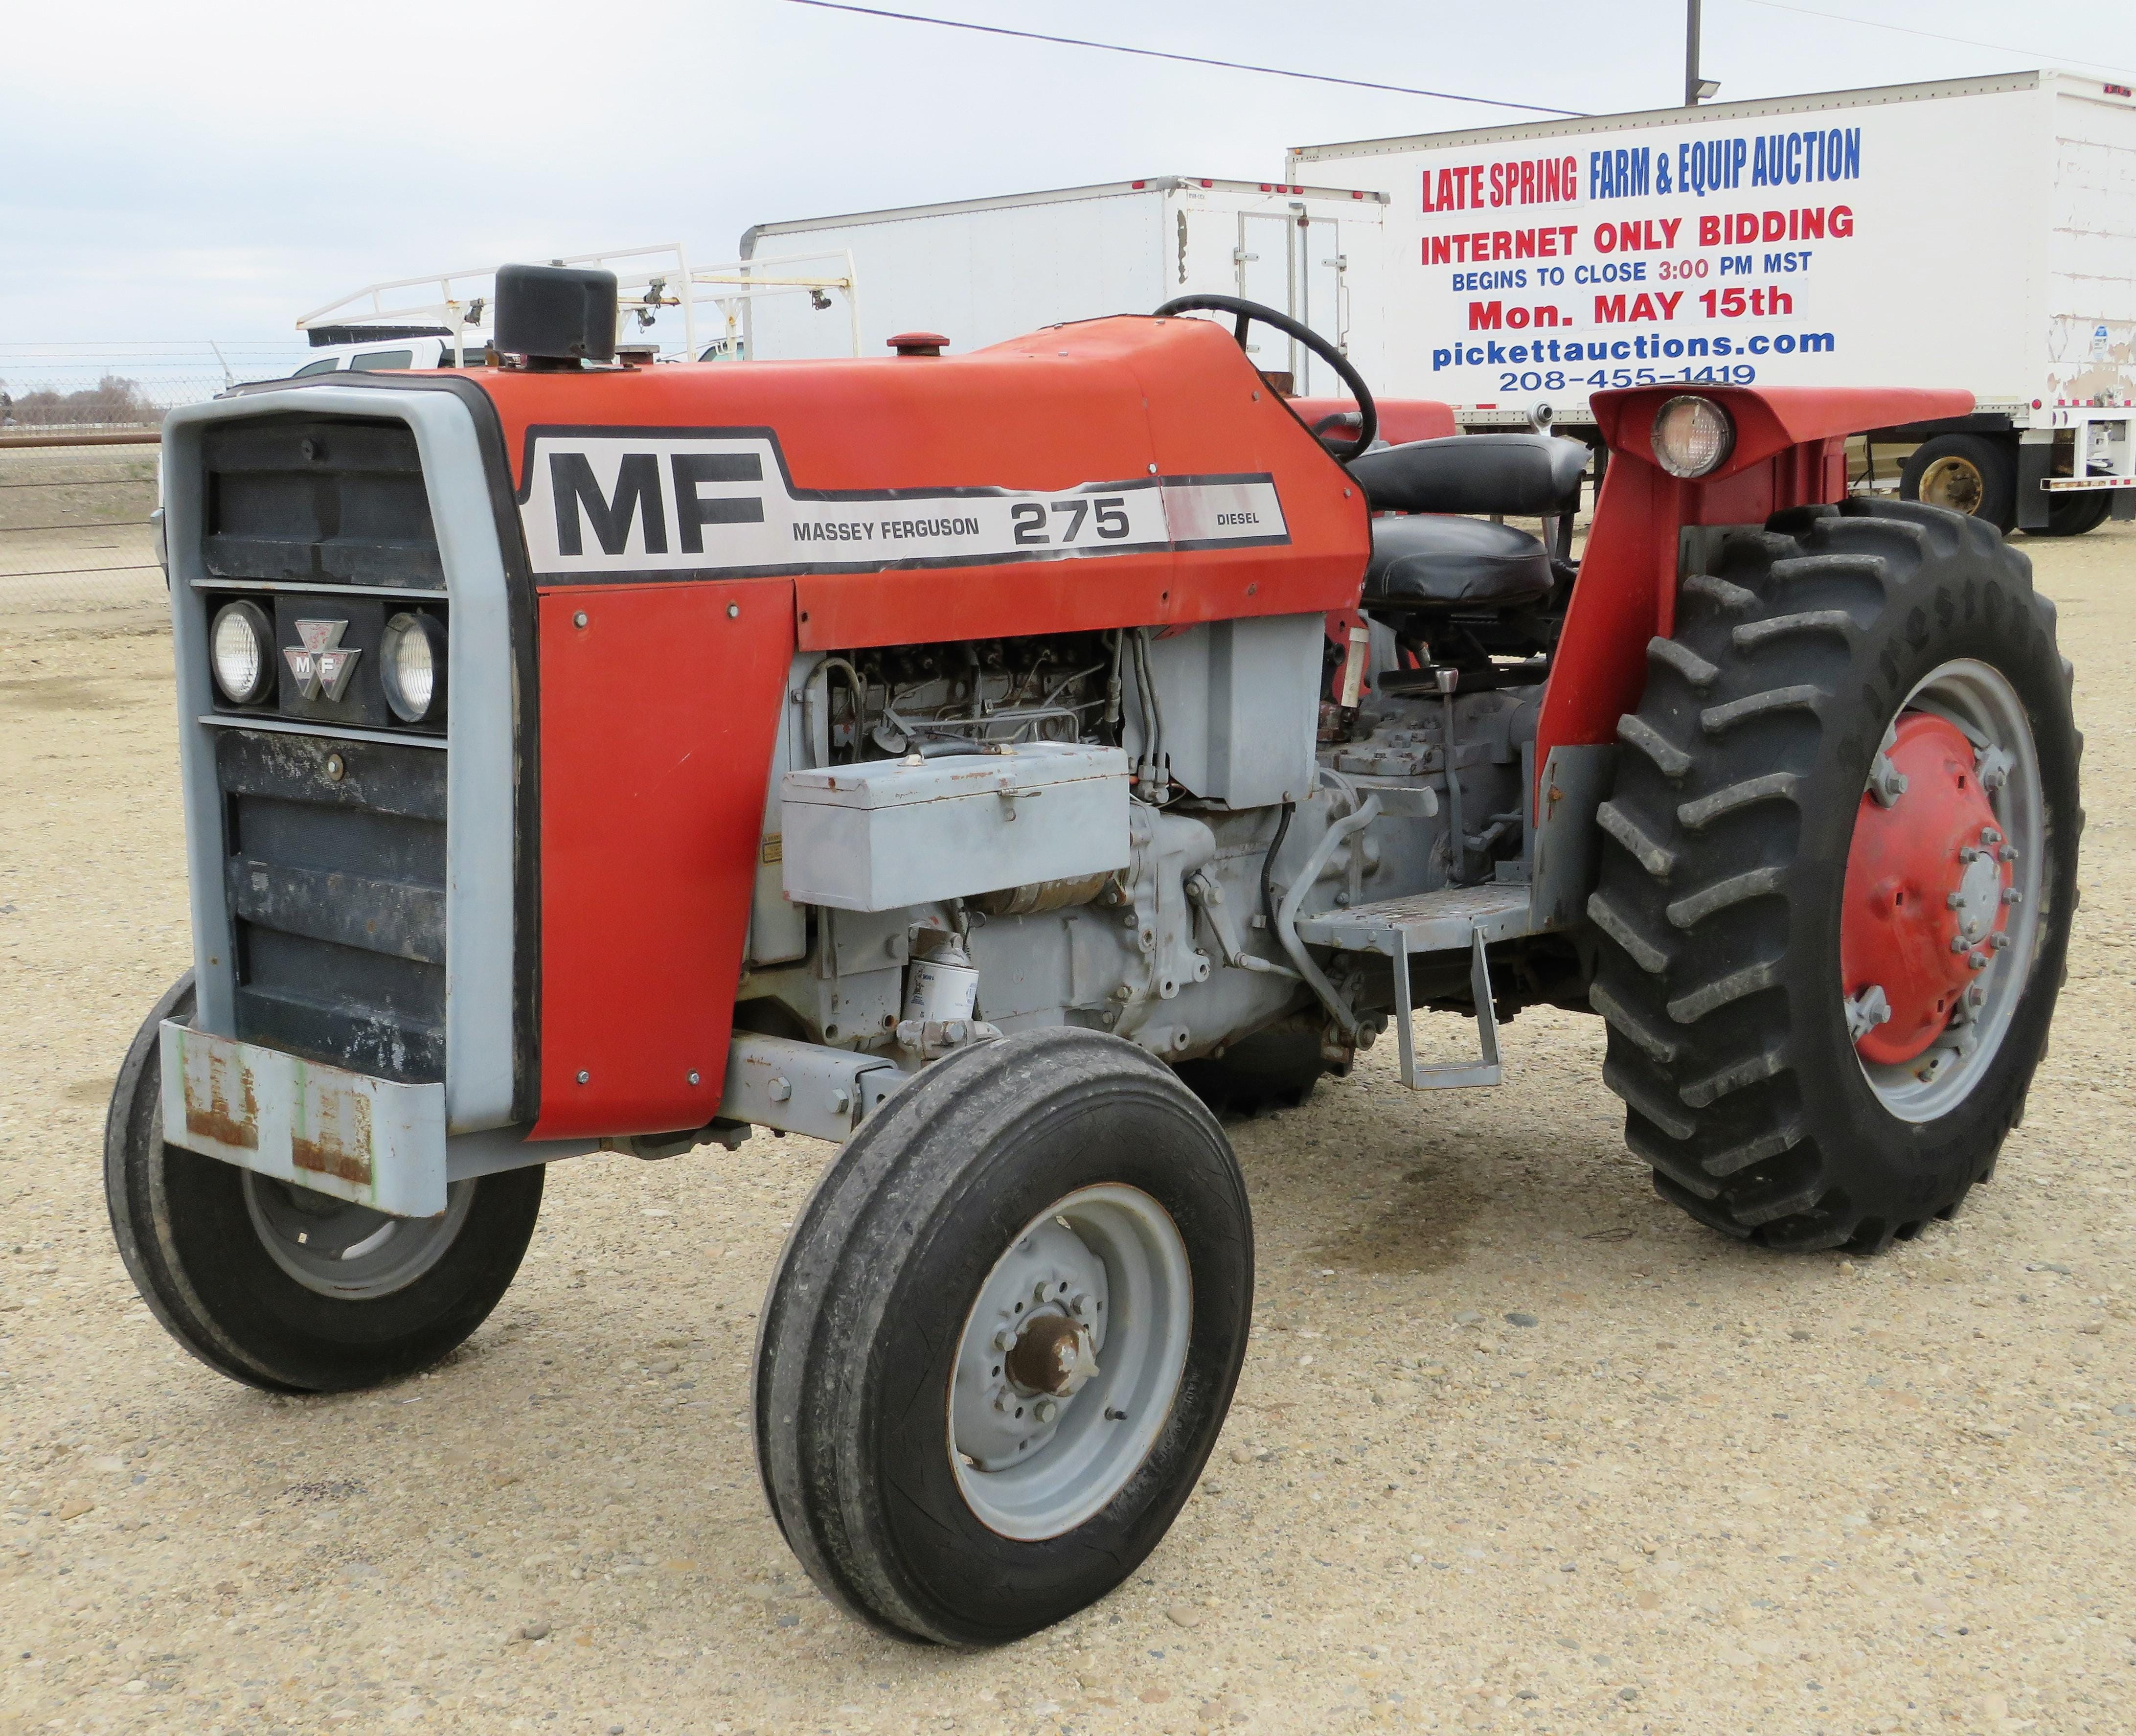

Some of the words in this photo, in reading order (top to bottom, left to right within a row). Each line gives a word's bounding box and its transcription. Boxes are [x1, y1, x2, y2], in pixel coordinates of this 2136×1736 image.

[1422, 165, 1484, 212] LATE
[1491, 157, 1576, 207] SPRING
[1590, 147, 1649, 198] FARM
[1657, 153, 1671, 194] &
[1679, 138, 1746, 196] EQUIP
[1751, 129, 1860, 186] AUCTION
[1422, 226, 1578, 265] INTERNET
[1594, 218, 1681, 253] ONLY
[1700, 206, 1853, 246] BIDDING
[1453, 270, 1526, 290] BEGINS
[1537, 267, 1564, 285] TO
[1574, 262, 1646, 283] CLOSE
[1659, 259, 1708, 280] 3:00
[1721, 256, 1751, 274] PM
[1764, 252, 1811, 271] MST
[1469, 301, 1572, 330] Mon.
[1595, 291, 1683, 323] MAY
[1700, 286, 1792, 318] 15th
[1432, 331, 1835, 371] pickettauctions.com
[1500, 364, 1756, 391] 208-455-1419
[549, 454, 764, 556] MF
[1011, 498, 1130, 545] 275
[1218, 513, 1259, 525] DIESEL
[793, 523, 873, 540] MASSEY
[882, 518, 978, 539] FERGUSON
